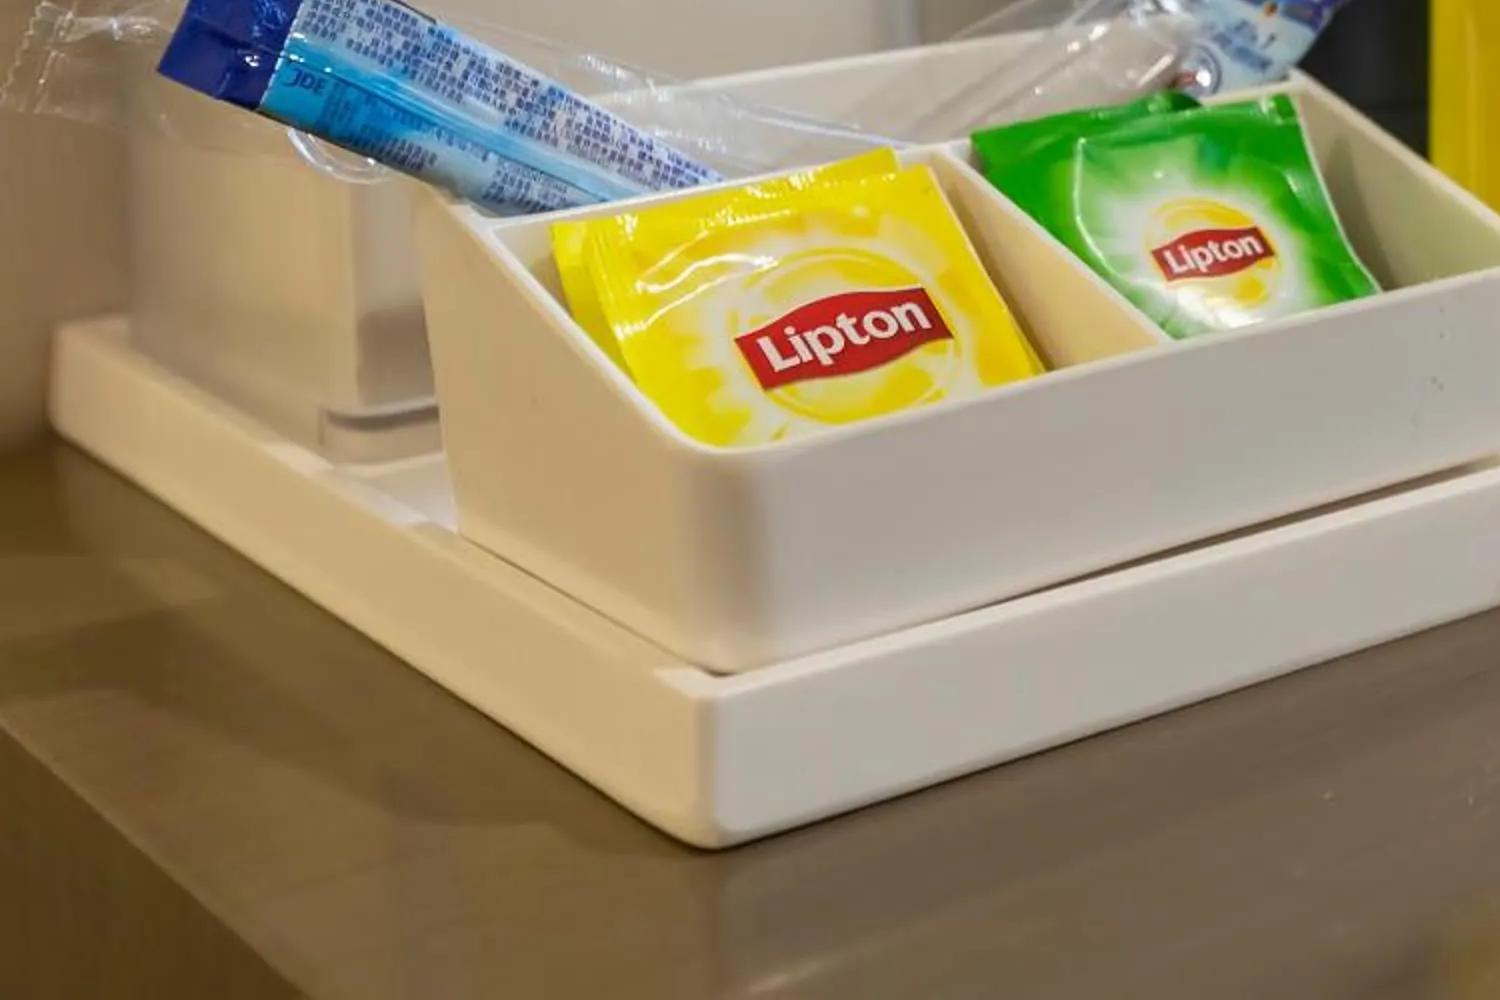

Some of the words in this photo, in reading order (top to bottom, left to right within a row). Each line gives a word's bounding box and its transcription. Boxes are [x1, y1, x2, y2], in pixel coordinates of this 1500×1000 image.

[283, 67, 327, 96] JDE
[1163, 235, 1265, 275] Lipton
[756, 301, 933, 373] Lipton
